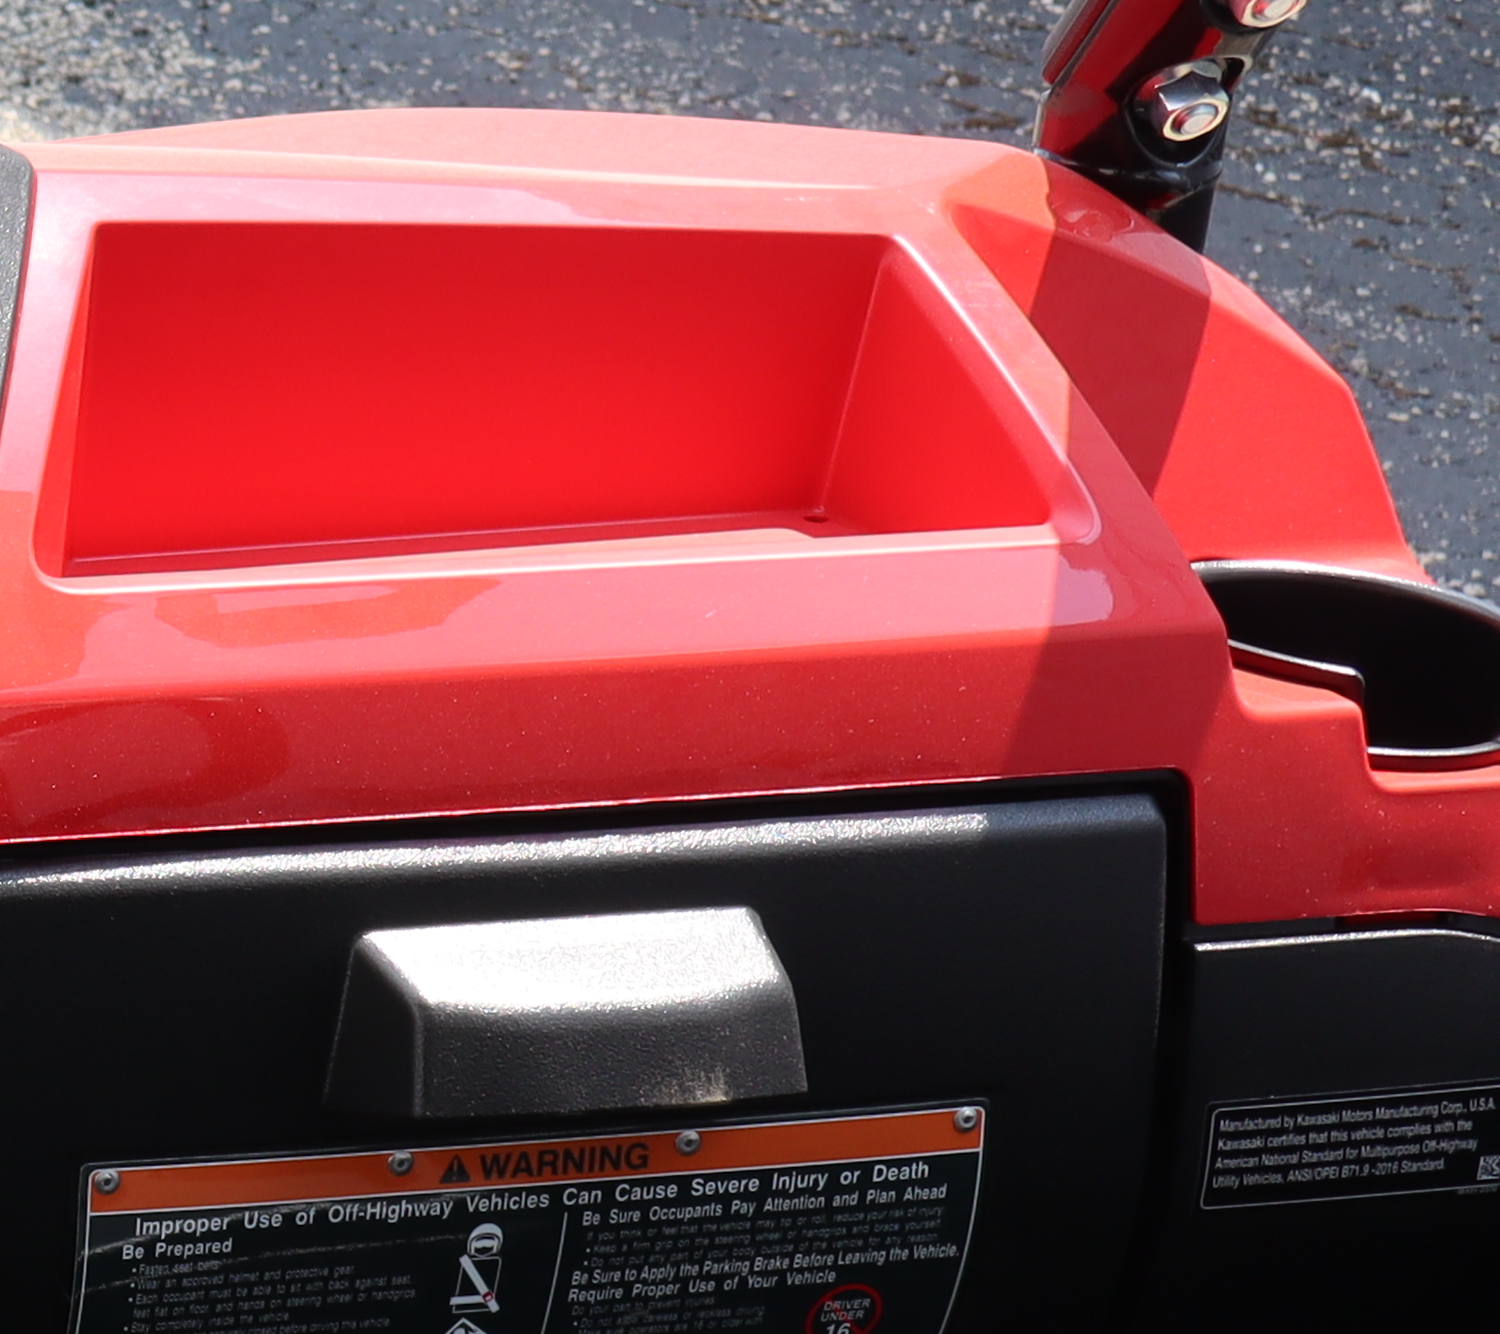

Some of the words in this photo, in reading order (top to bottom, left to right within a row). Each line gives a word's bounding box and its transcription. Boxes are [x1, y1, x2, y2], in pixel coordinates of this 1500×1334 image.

[1219, 1114, 1281, 1132] Manufactured
[1283, 1115, 1295, 1131] by
[1296, 1110, 1340, 1126] Kawasaki
[1341, 1108, 1374, 1122] Motors
[1375, 1102, 1439, 1120] Manufacturing
[1217, 1136, 1265, 1151] Kawasaki
[1266, 1133, 1306, 1148] certifies
[1308, 1131, 1329, 1144] that
[1330, 1129, 1349, 1143] this
[1350, 1126, 1385, 1141] vehicle
[1386, 1122, 1432, 1139] complies
[1433, 1120, 1455, 1134] with
[1456, 1119, 1473, 1132] the
[480, 1142, 651, 1180] WARNING
[1215, 1155, 1259, 1170] American
[1260, 1151, 1300, 1167] National
[1301, 1148, 1344, 1164] Standard
[1345, 1146, 1359, 1160] for
[1360, 1142, 1420, 1160] Multipurpose
[1421, 1138, 1479, 1154] Off-Highway
[1212, 1174, 1241, 1189] Utility
[135, 1216, 230, 1238] Improper
[243, 1211, 283, 1229] Use
[295, 1208, 316, 1226] of
[328, 1198, 454, 1224] Off-Highway
[466, 1191, 550, 1213] Vehicles
[562, 1187, 602, 1207] Can
[615, 1181, 679, 1202] Cause
[690, 1176, 760, 1197] Severe
[772, 1168, 828, 1192] Injury
[840, 1169, 861, 1185] or
[872, 1161, 930, 1184] Death
[581, 1210, 600, 1226] Be
[608, 1208, 641, 1225] Sure
[649, 1202, 723, 1224] Occupants
[730, 1199, 757, 1218] Pay
[763, 1193, 825, 1213] Attention
[832, 1191, 858, 1207] and
[865, 1188, 896, 1205] Plan
[902, 1183, 947, 1202] Ahead
[121, 1244, 144, 1261] Be
[155, 1237, 234, 1260] Prepared
[571, 1270, 590, 1286] Be
[592, 1267, 622, 1285] Sure
[624, 1266, 638, 1282] to
[639, 1263, 677, 1285] Apply
[679, 1261, 700, 1277] the
[702, 1256, 750, 1278] Parking
[753, 1253, 790, 1272] Brake
[792, 1250, 834, 1269] Before
[836, 1246, 887, 1268] Leaving
[889, 1245, 909, 1262] the
[912, 1241, 960, 1259] Vehicle.
[567, 1284, 624, 1305] Require
[631, 1281, 680, 1303] Proper
[688, 1277, 715, 1294] Use
[723, 1275, 739, 1291] of
[747, 1272, 777, 1289] Your
[786, 1269, 836, 1286] Vehicle
[820, 1308, 865, 1323] UNDER
[822, 1297, 871, 1312] DRIVER
